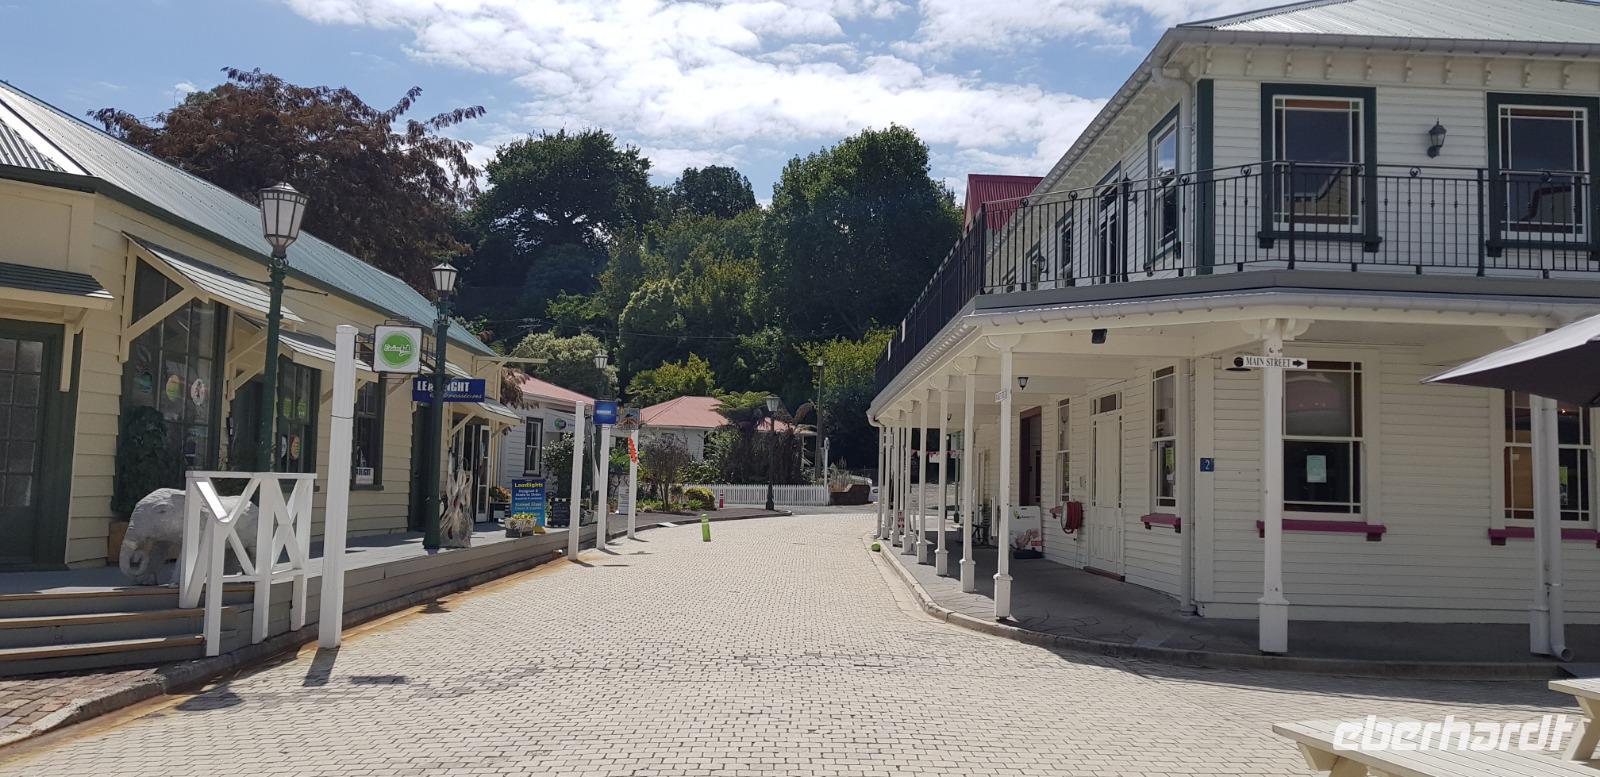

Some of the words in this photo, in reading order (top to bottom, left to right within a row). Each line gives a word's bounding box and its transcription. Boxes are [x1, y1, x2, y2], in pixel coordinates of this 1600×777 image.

[1245, 356, 1264, 366] MAIN
[1265, 358, 1290, 368] STREET
[1205, 459, 1210, 470] 2
